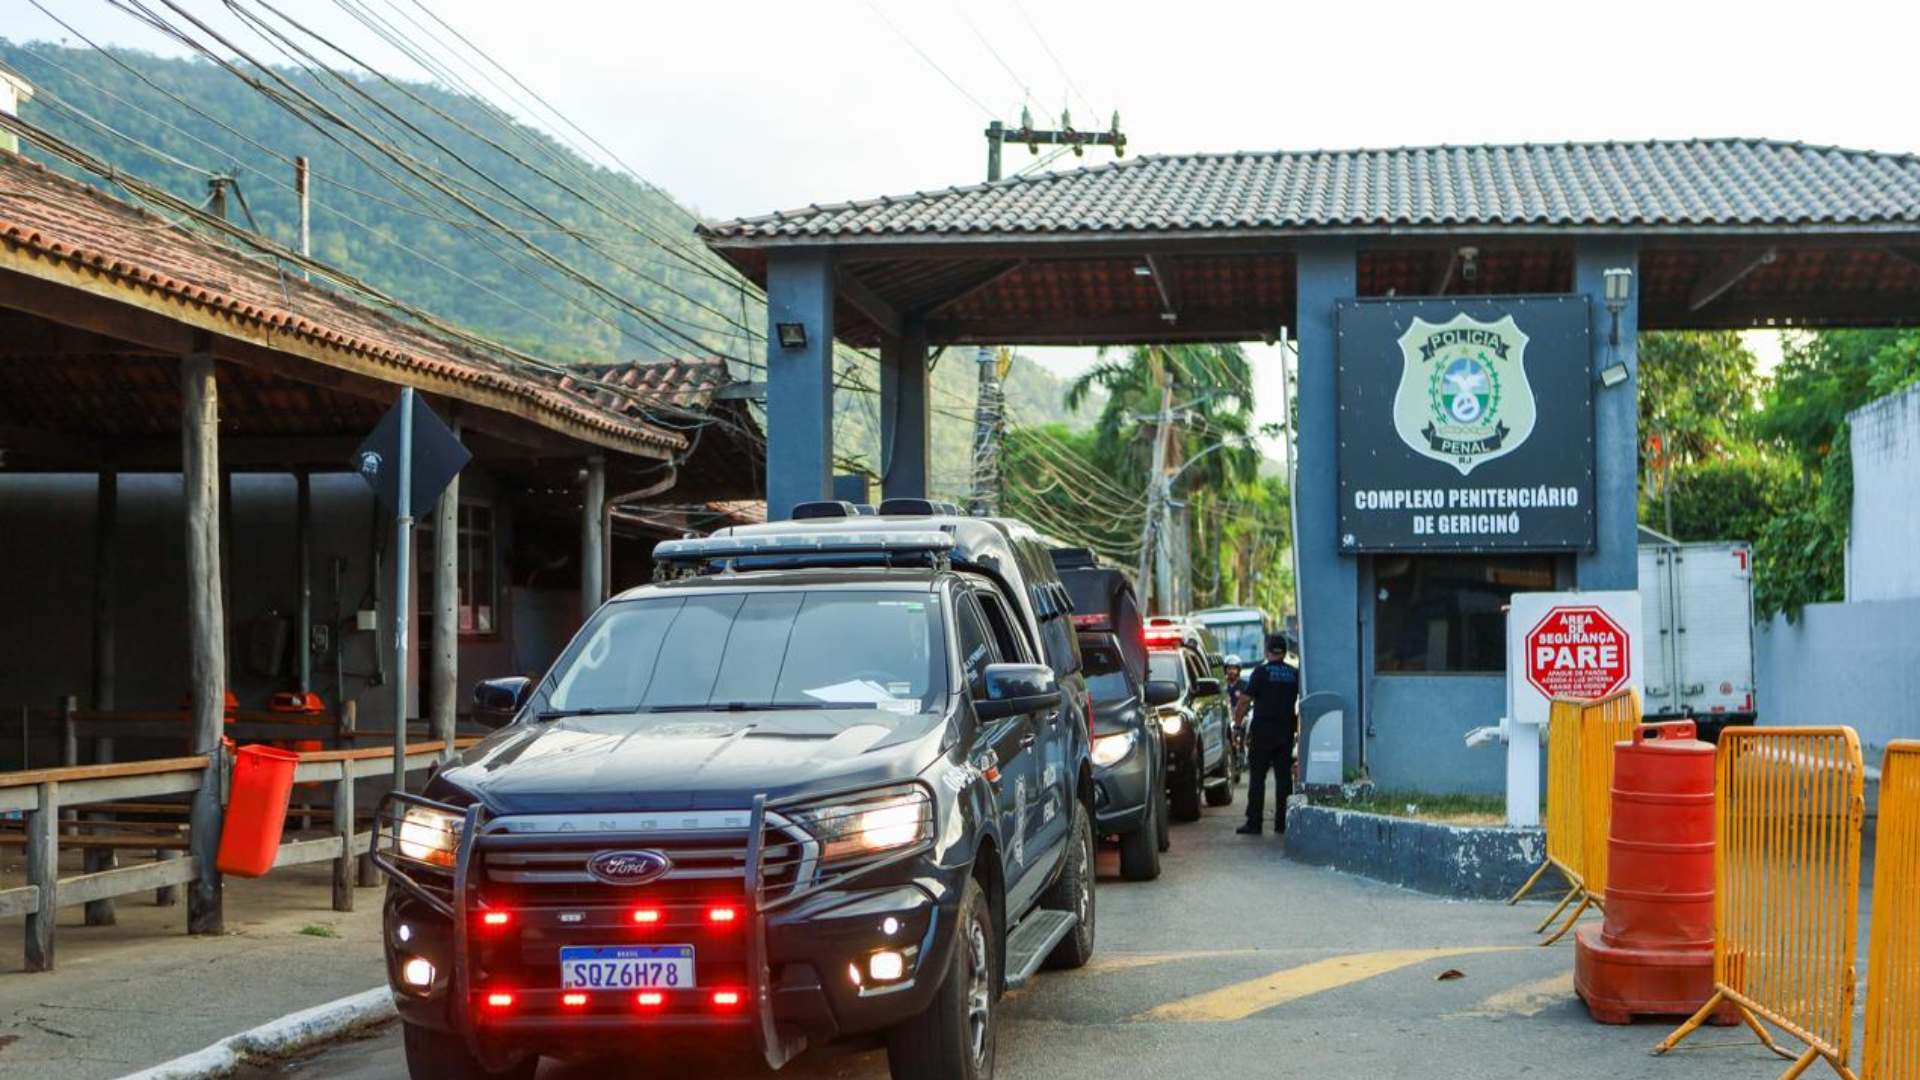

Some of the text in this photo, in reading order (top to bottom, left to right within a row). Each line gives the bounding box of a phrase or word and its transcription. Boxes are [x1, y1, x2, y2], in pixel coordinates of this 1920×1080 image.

[1441, 440, 1491, 453] PENAL
[1458, 456, 1472, 464] RJ
[1355, 484, 1579, 509] COMPLEXO PENITENCIÁRIO
[1413, 511, 1520, 534] DE GERICINÓ
[1560, 613, 1593, 625] ÁREA
[1568, 624, 1585, 634] DE
[1538, 632, 1615, 645] SEGURANÇA
[1536, 645, 1619, 670] PARE
[518, 817, 742, 832] RANGER
[605, 858, 648, 875] Ford
[574, 963, 678, 987] SQZ6H78
